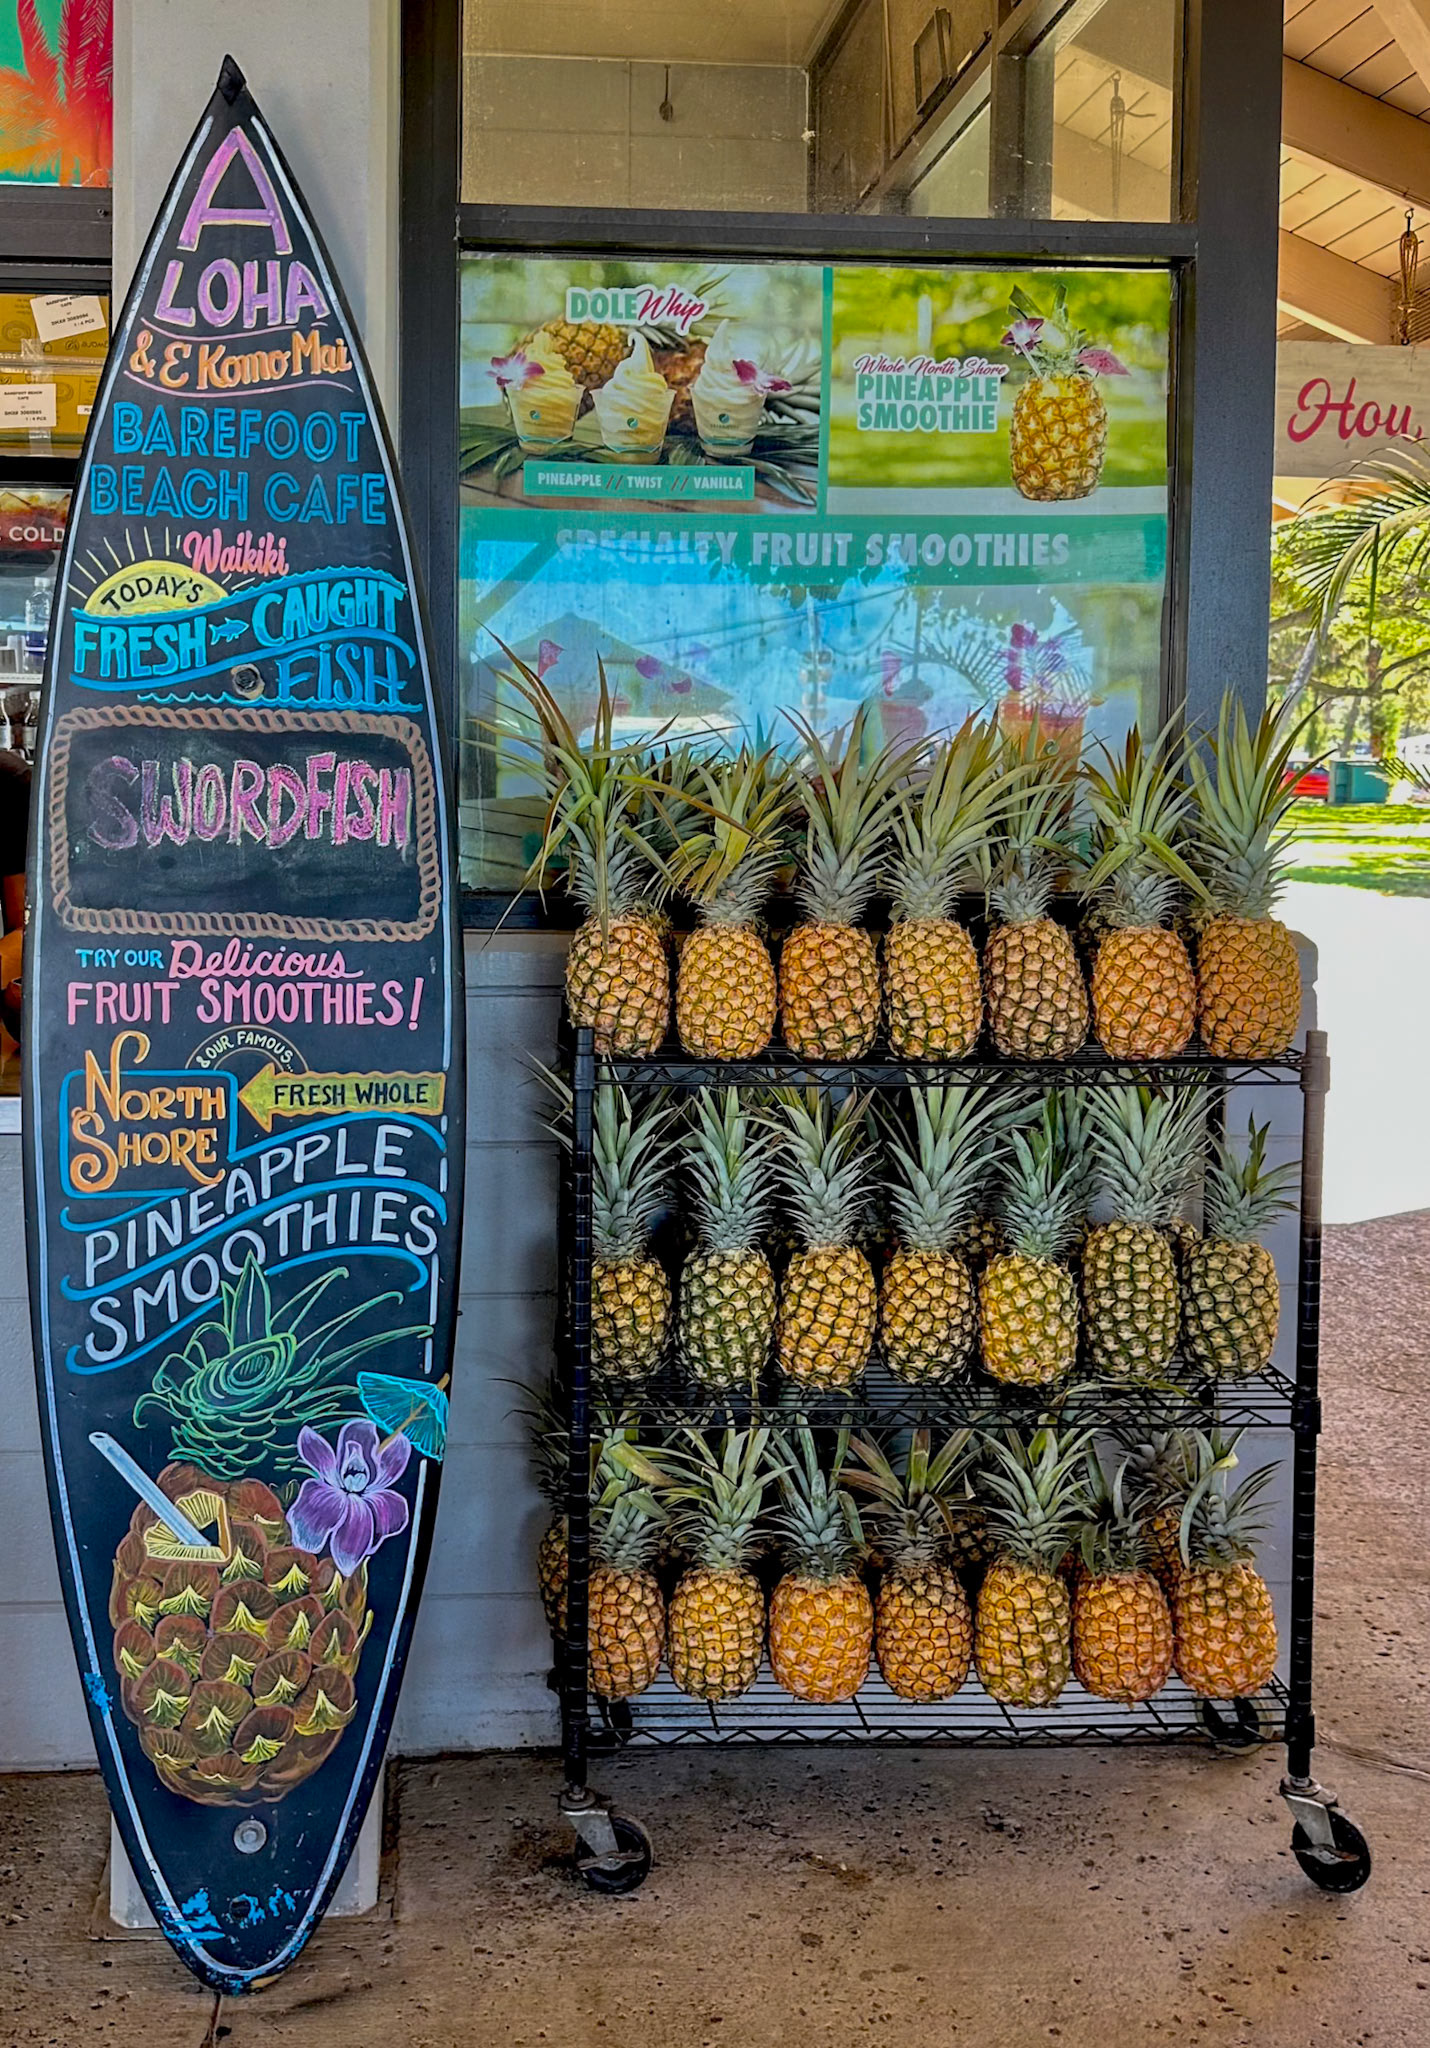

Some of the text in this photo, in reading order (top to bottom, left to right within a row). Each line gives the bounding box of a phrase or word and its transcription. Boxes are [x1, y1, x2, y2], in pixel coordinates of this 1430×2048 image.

[154, 258, 330, 328] LOHA
[570, 288, 705, 330] DOLE Whip
[197, 344, 292, 390] Komo
[290, 329, 352, 376] Mai
[855, 355, 1007, 378] Whole North Shore
[858, 374, 998, 402] PINEAPPLE
[112, 402, 366, 462] BAREFOOT
[859, 403, 995, 430] SMOOTHIE
[90, 464, 387, 525] BEACH CAFE
[538, 472, 743, 489] PINEAPPLE TWIST VANILLA
[9, 526, 65, 542] COLD
[183, 528, 289, 577] Waikiki
[752, 532, 852, 566] FRUIT
[866, 533, 1070, 567] SMOOTHIES
[101, 576, 204, 613] TODAY'S
[73, 577, 406, 679] FRESH CAUGHT
[86, 751, 413, 850] SWORDFISH
[75, 938, 364, 980] TRY OUR Delicious
[67, 977, 425, 1031] FRUIT SMOOTHIES!
[205, 1035, 235, 1059] OUR
[274, 1082, 429, 1107] FRESH WHOLE
[85, 1125, 414, 1287] PINEAPPLE
[85, 1191, 437, 1361] SMOOTHIES
